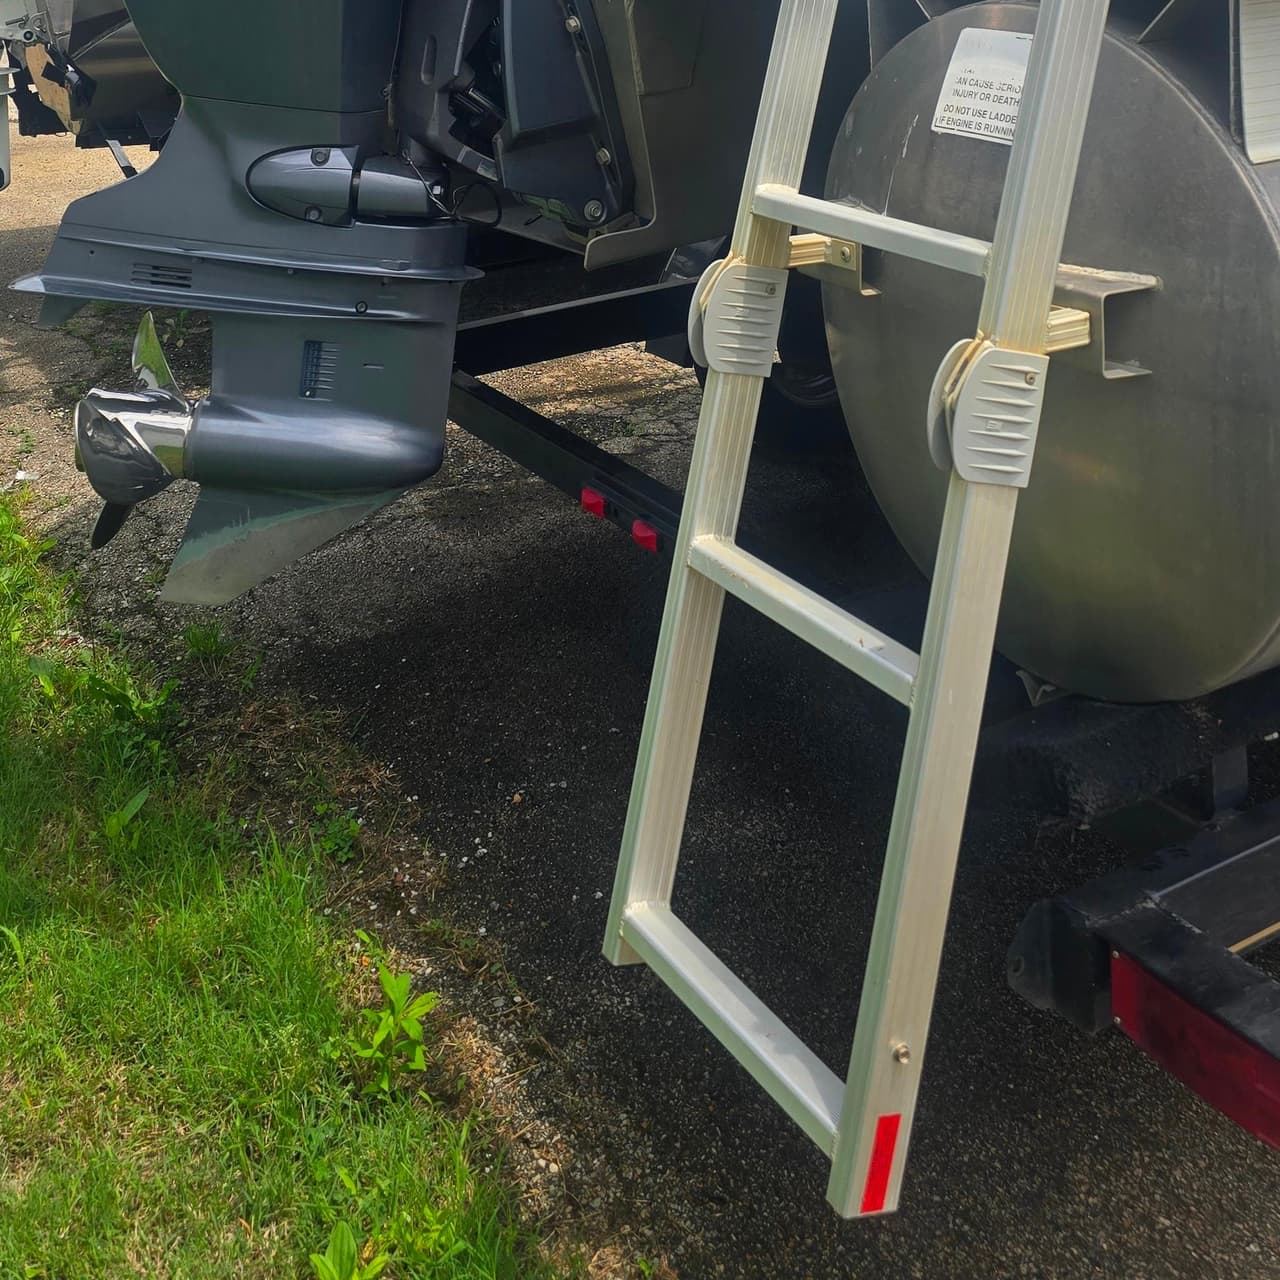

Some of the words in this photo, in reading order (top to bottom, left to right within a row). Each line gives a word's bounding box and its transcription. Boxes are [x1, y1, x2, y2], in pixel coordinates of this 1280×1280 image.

[968, 78, 996, 90] CAUSE
[952, 88, 979, 100] INJURY
[979, 92, 991, 102] OR
[992, 95, 1020, 107] DEATH
[943, 104, 954, 113] DO
[955, 105, 971, 116] NOT
[971, 108, 988, 119] USE
[938, 116, 946, 125] IF
[946, 117, 974, 129] ENGINE
[974, 121, 983, 131] IS
